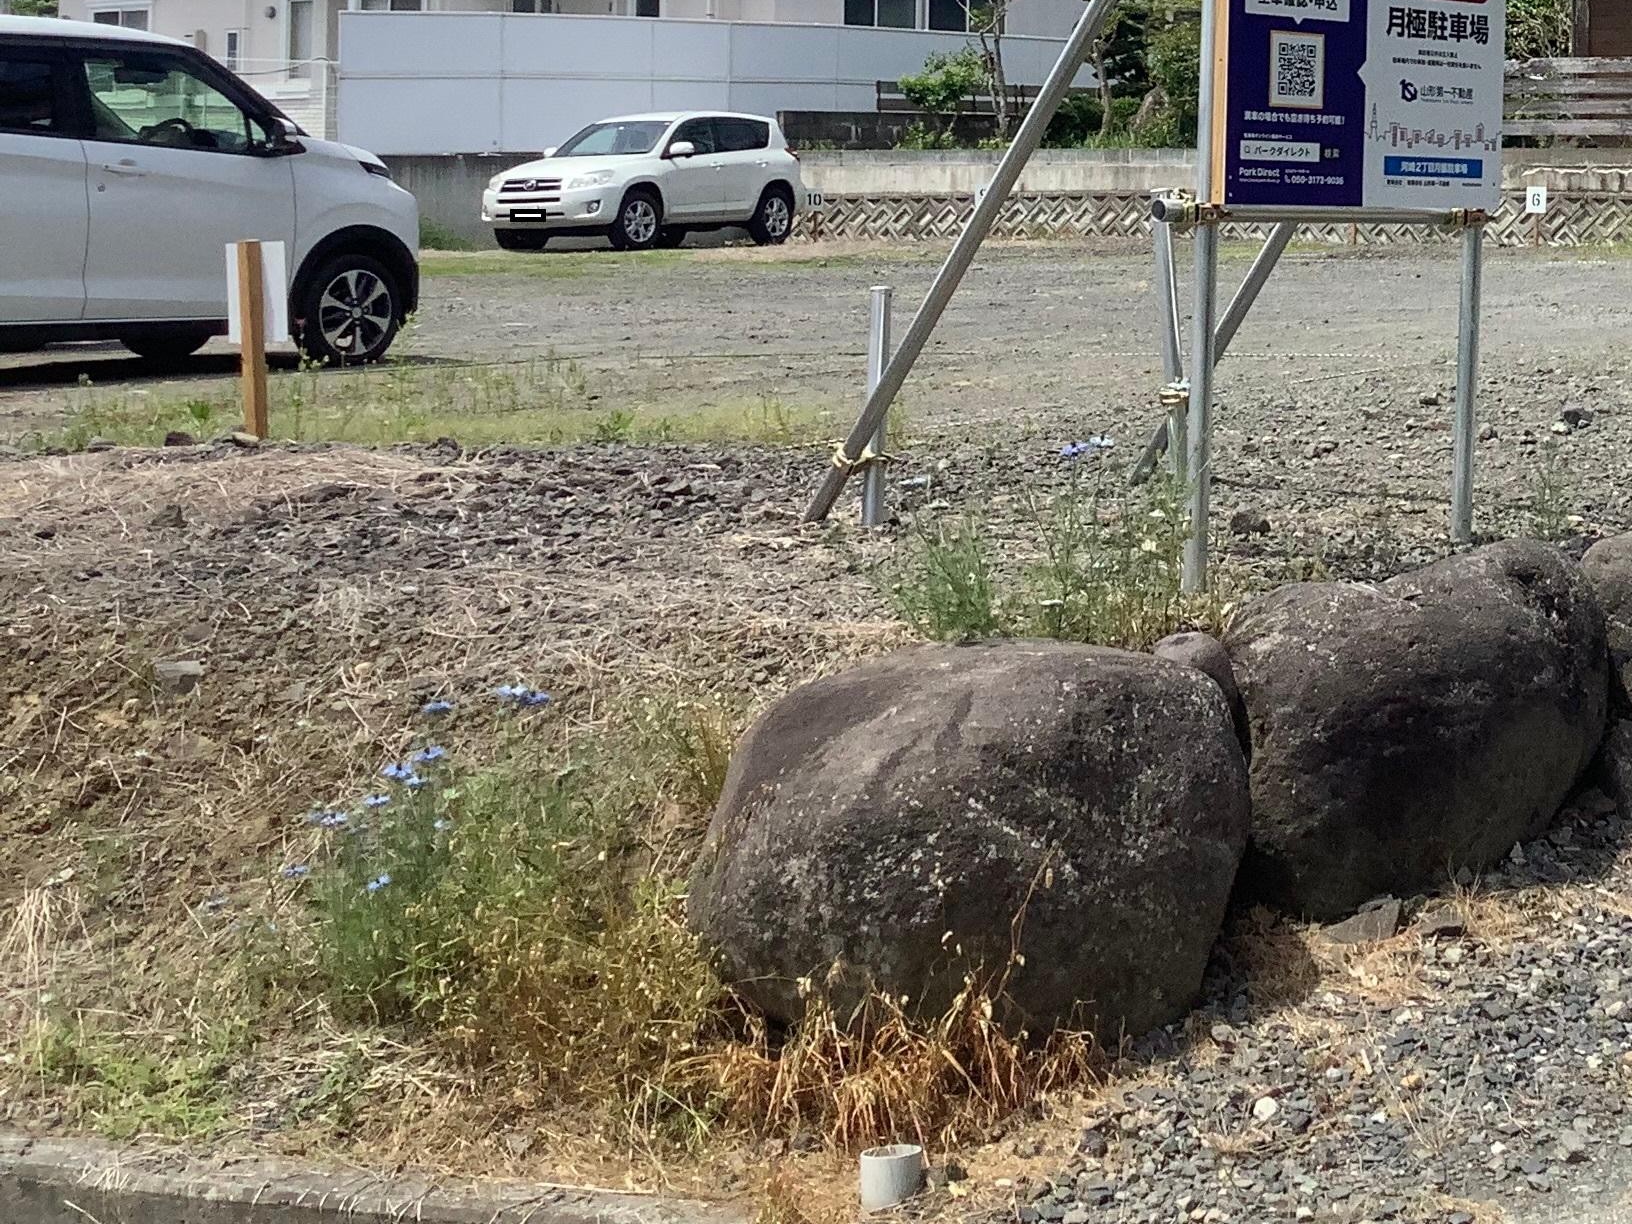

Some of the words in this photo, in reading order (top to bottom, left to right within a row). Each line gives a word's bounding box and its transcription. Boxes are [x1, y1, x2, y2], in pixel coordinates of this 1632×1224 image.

[1386, 6, 1489, 45] 月極駐車場
[1420, 85, 1473, 100] 山形第一不動産
[1254, 145, 1311, 157] パークダイレクト
[807, 193, 822, 206] 10
[1531, 192, 1541, 207] 6
